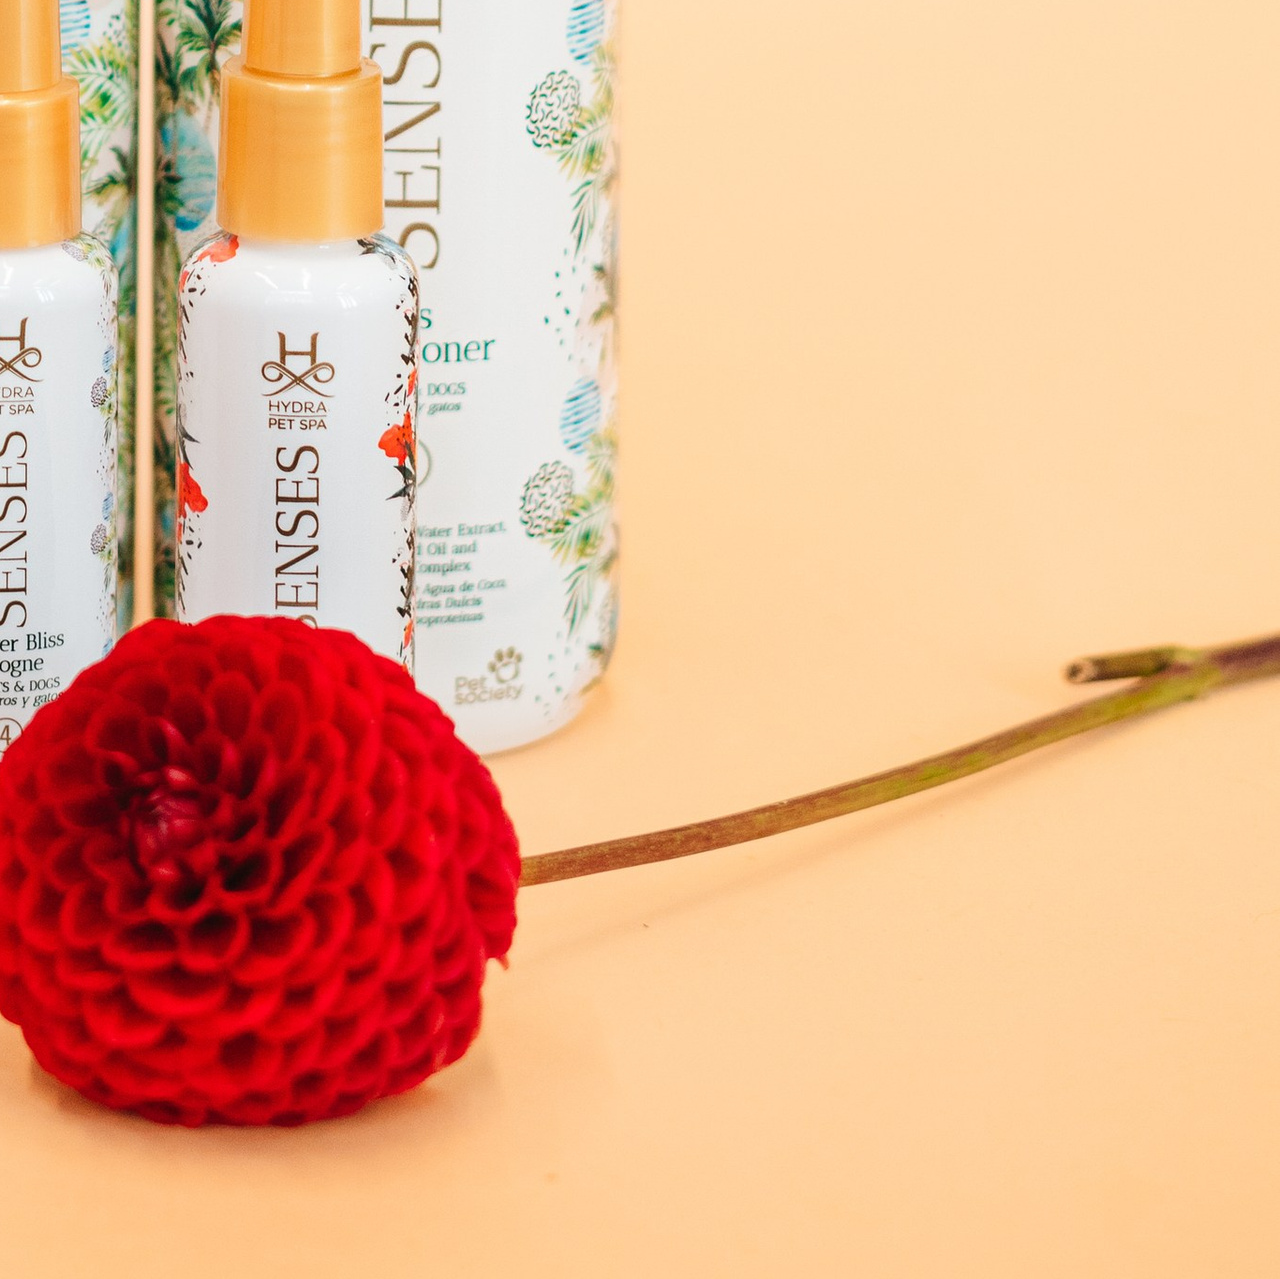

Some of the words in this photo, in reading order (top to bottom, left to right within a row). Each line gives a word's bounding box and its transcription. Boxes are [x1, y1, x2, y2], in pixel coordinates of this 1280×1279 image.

[426, 381, 467, 396] DOGS
[9, 403, 35, 416] SPA
[268, 399, 327, 414] HYDRA
[268, 417, 295, 430] PET
[299, 418, 328, 431] SPA
[451, 539, 478, 555] and
[25, 631, 65, 652] Bliss
[13, 681, 25, 693] &
[29, 676, 61, 692] DOGS
[454, 675, 488, 694] Pet
[21, 696, 31, 709] y
[453, 683, 525, 706] society
[0, 724, 12, 746] 4
